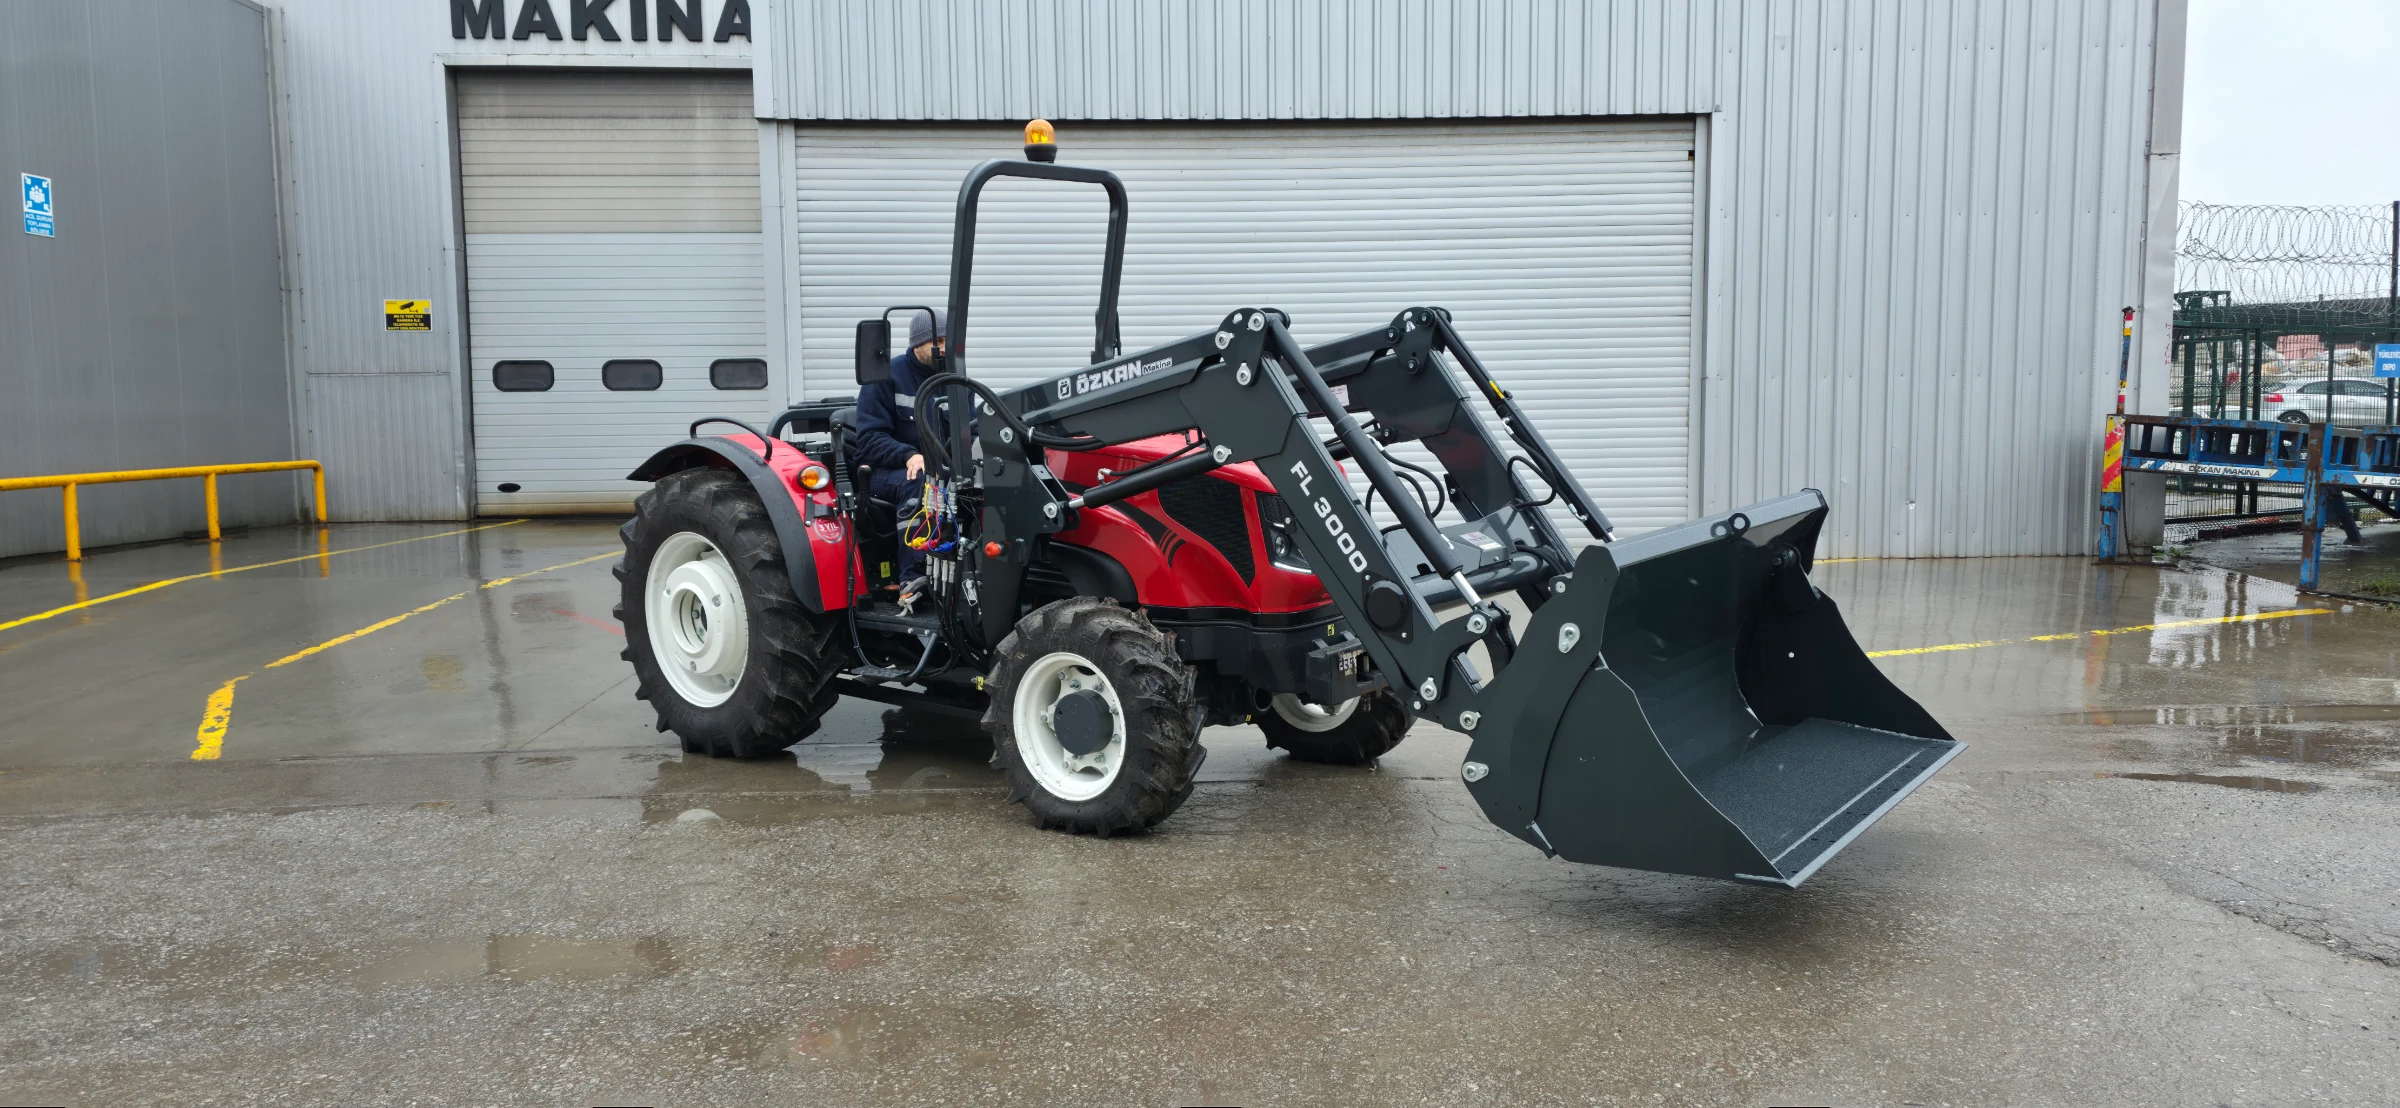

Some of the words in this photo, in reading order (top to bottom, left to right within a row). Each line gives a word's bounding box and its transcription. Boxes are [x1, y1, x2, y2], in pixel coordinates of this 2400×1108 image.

[1076, 360, 1142, 394] ÖZKAN
[2382, 363, 2396, 371] DEPO
[1290, 460, 1313, 497] FL
[1313, 496, 1368, 573] 3000
